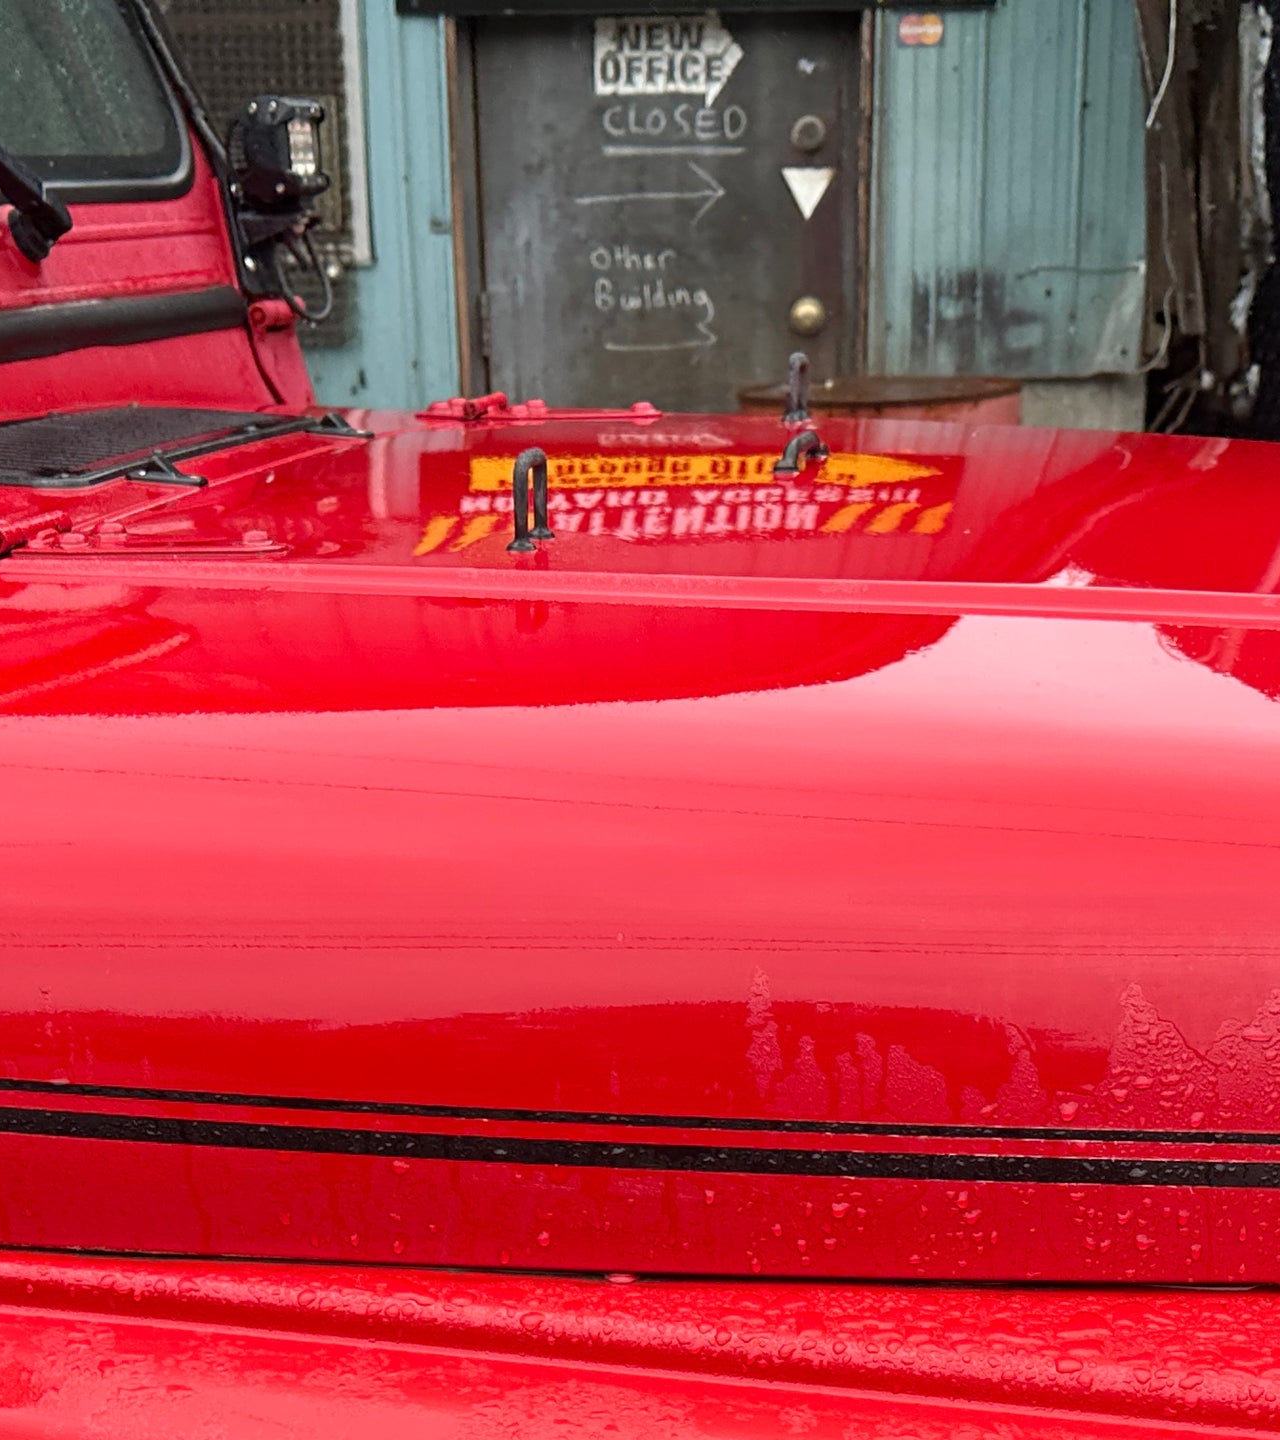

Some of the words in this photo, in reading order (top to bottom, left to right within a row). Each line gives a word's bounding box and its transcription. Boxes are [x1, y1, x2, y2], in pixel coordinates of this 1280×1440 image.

[616, 21, 704, 50] NEW
[600, 51, 722, 85] OFFICE
[602, 103, 748, 139] CLOSED
[590, 245, 677, 271] Other
[594, 277, 715, 324] Building
